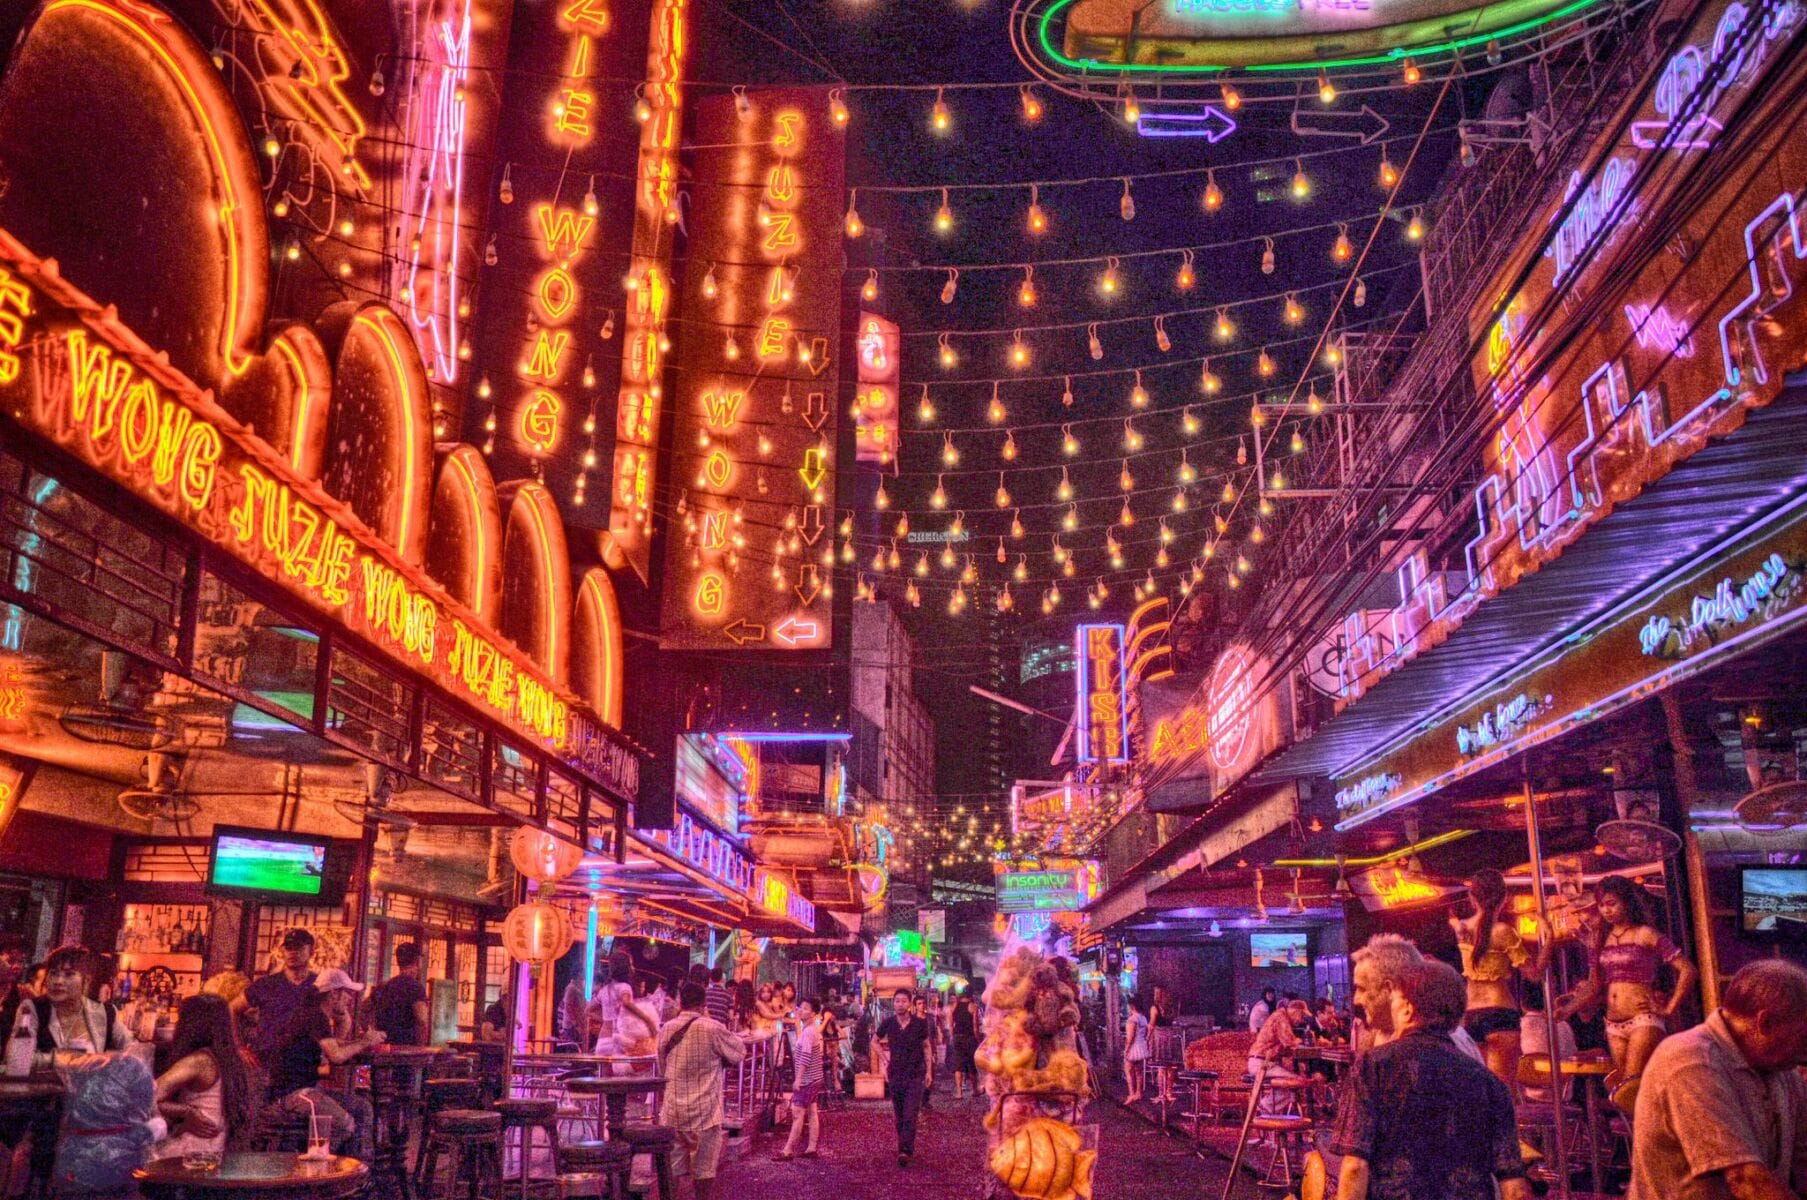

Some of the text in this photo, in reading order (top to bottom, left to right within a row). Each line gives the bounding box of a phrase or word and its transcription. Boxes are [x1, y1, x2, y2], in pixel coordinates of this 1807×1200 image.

[520, 205, 594, 450] WONG
[695, 112, 800, 613] SUZIE WONG
[68, 329, 222, 510] WONG
[229, 463, 356, 606] SUZIE
[361, 555, 437, 663] WONG
[448, 619, 515, 712] SUZIE
[517, 672, 567, 748] WONG
